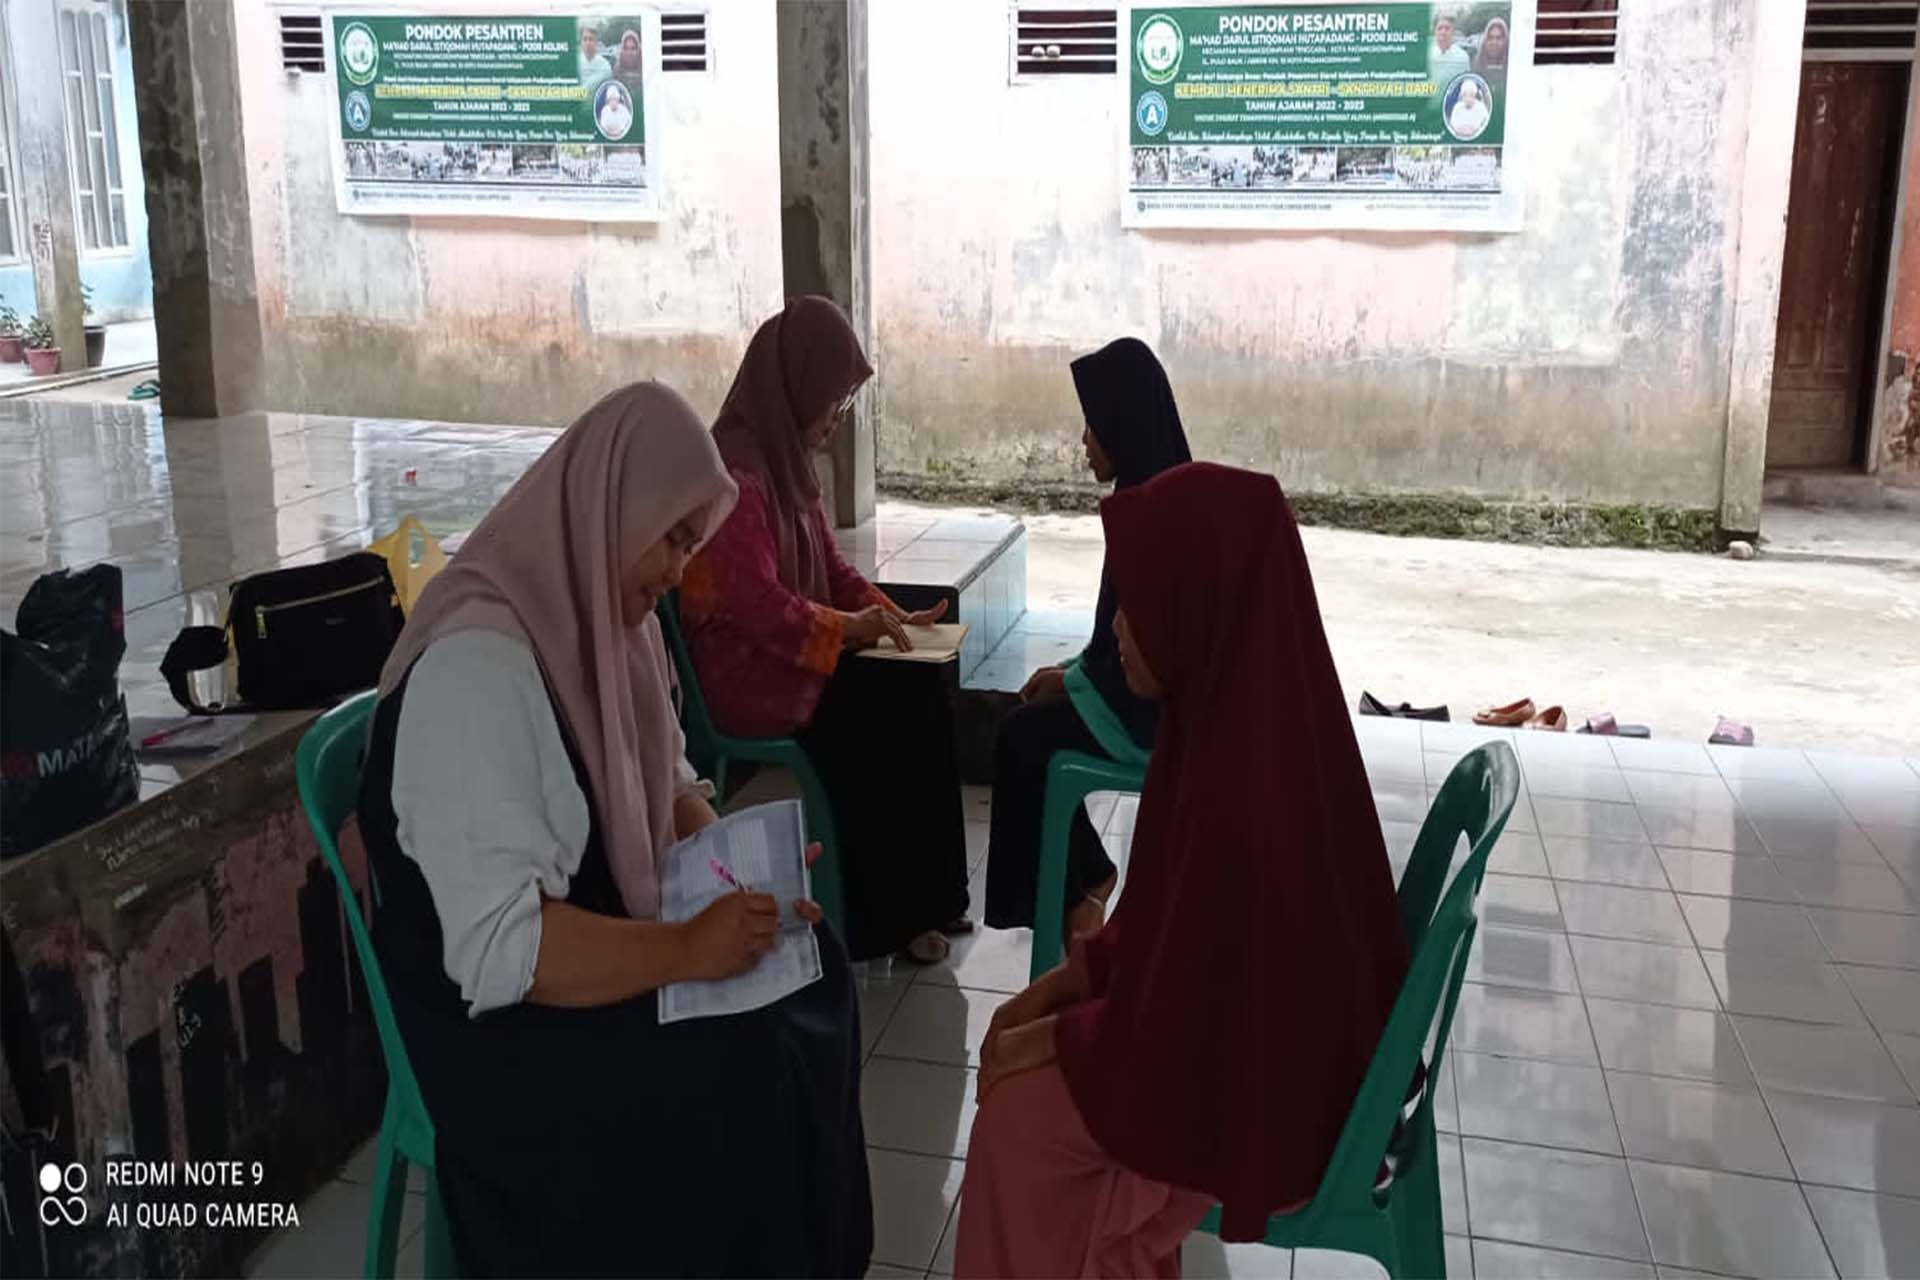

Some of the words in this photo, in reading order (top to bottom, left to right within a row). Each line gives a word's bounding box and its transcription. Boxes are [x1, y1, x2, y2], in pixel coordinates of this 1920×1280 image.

[1219, 15, 1289, 33] PONDOK
[1293, 13, 1390, 32] PESANTREN
[405, 24, 464, 40] PONDOK
[466, 24, 544, 41] PESANTREN
[1245, 101, 1276, 111] TAHUN
